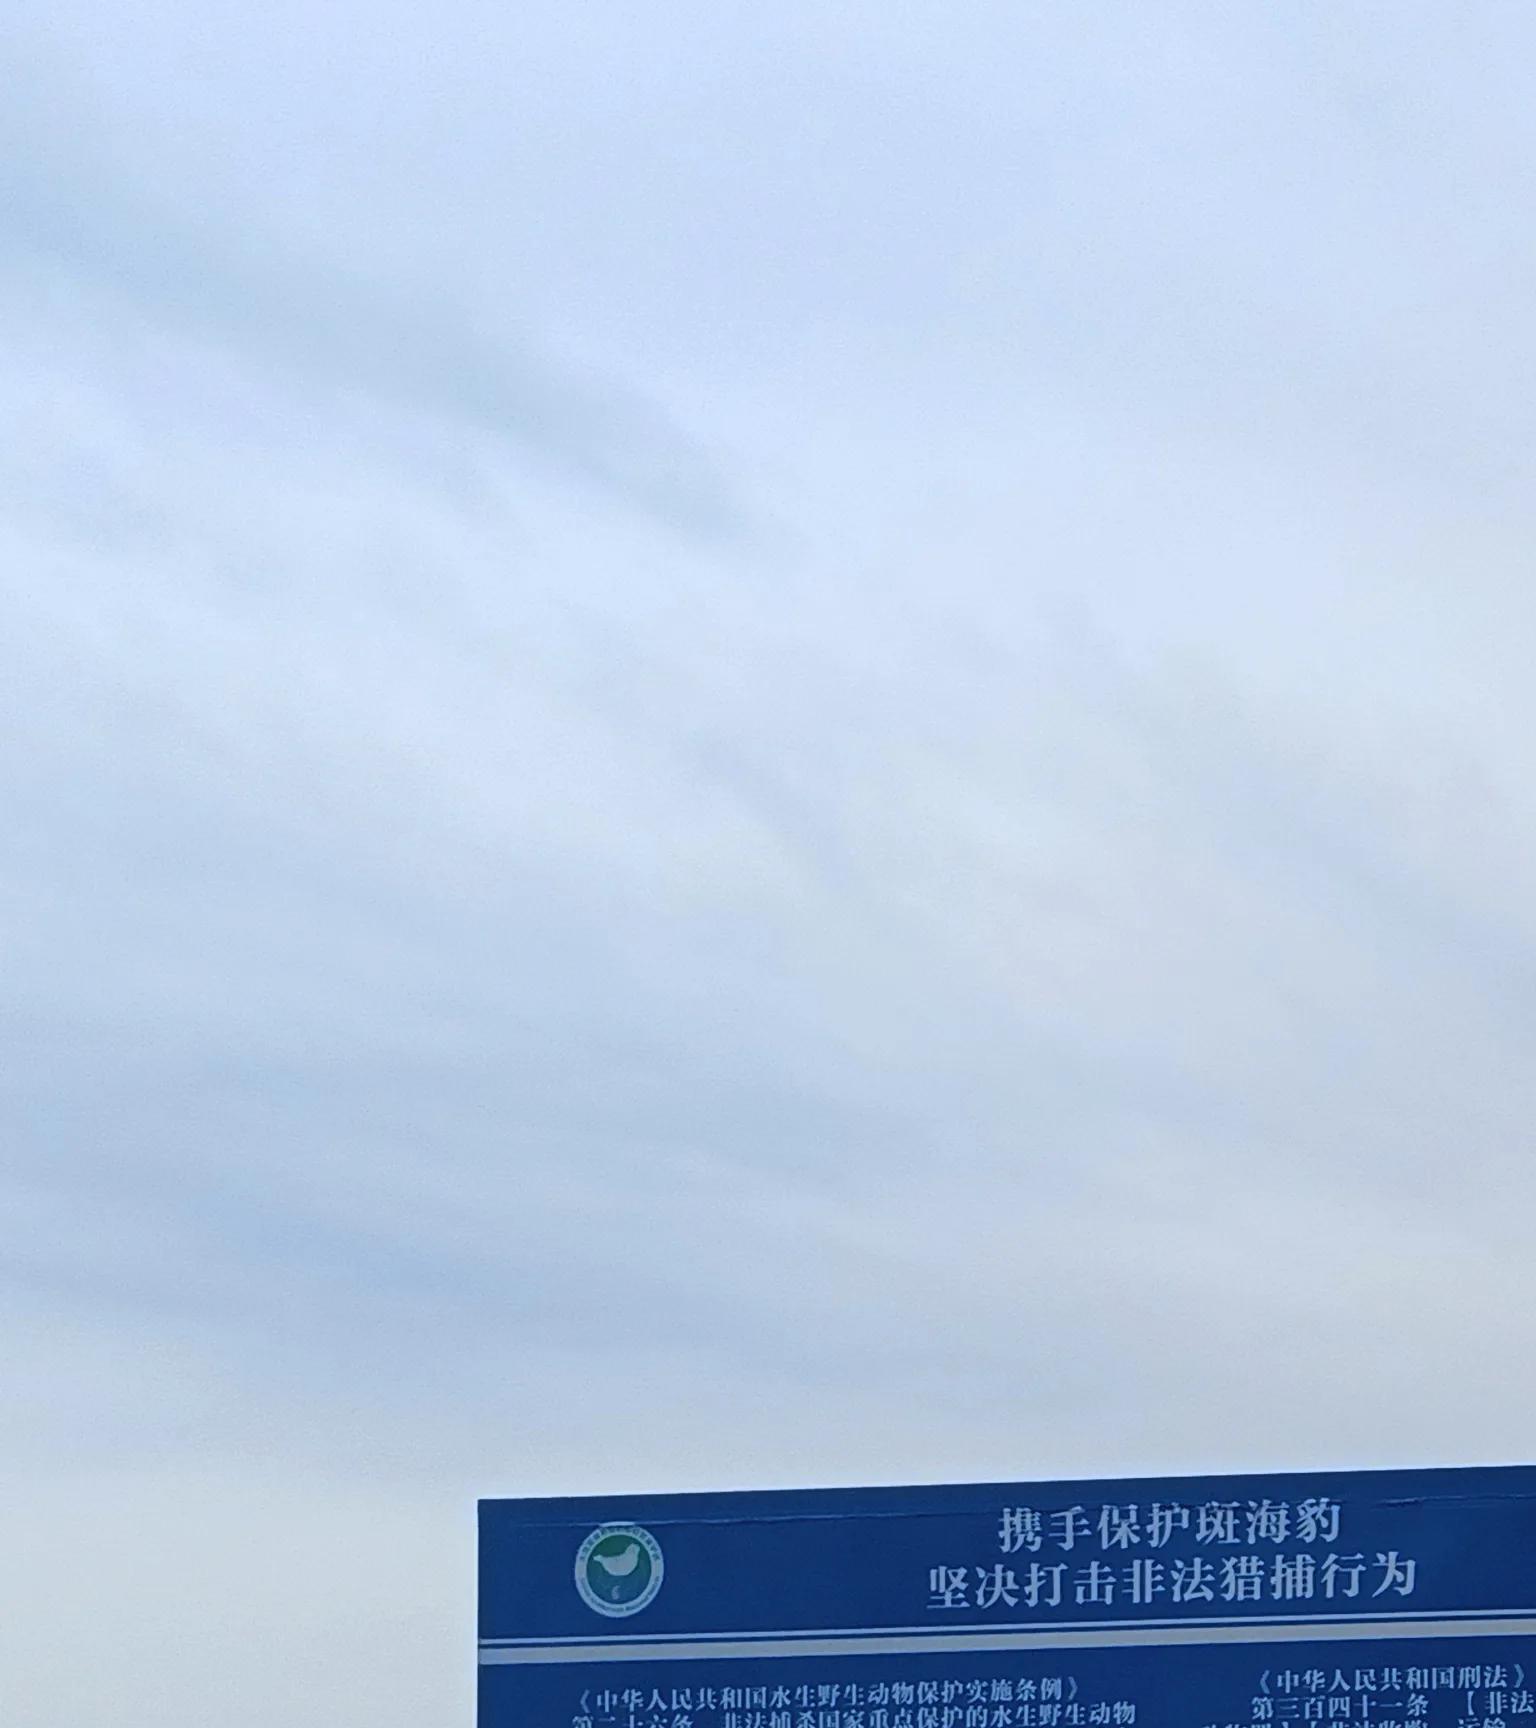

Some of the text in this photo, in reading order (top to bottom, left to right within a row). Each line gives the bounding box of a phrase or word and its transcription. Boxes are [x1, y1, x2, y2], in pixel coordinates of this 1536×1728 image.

[999, 1497, 1341, 1553] 携手保护斑海豹
[926, 1551, 1417, 1610] 坚决打击非法猎捕行为
[580, 1677, 1078, 1713] 《中华人民共和国水生野生动物保护实施条例》
[1259, 1664, 1524, 1694] 《中华人民共和国刑法》
[1251, 1691, 1429, 1720] 第三百四十一条
